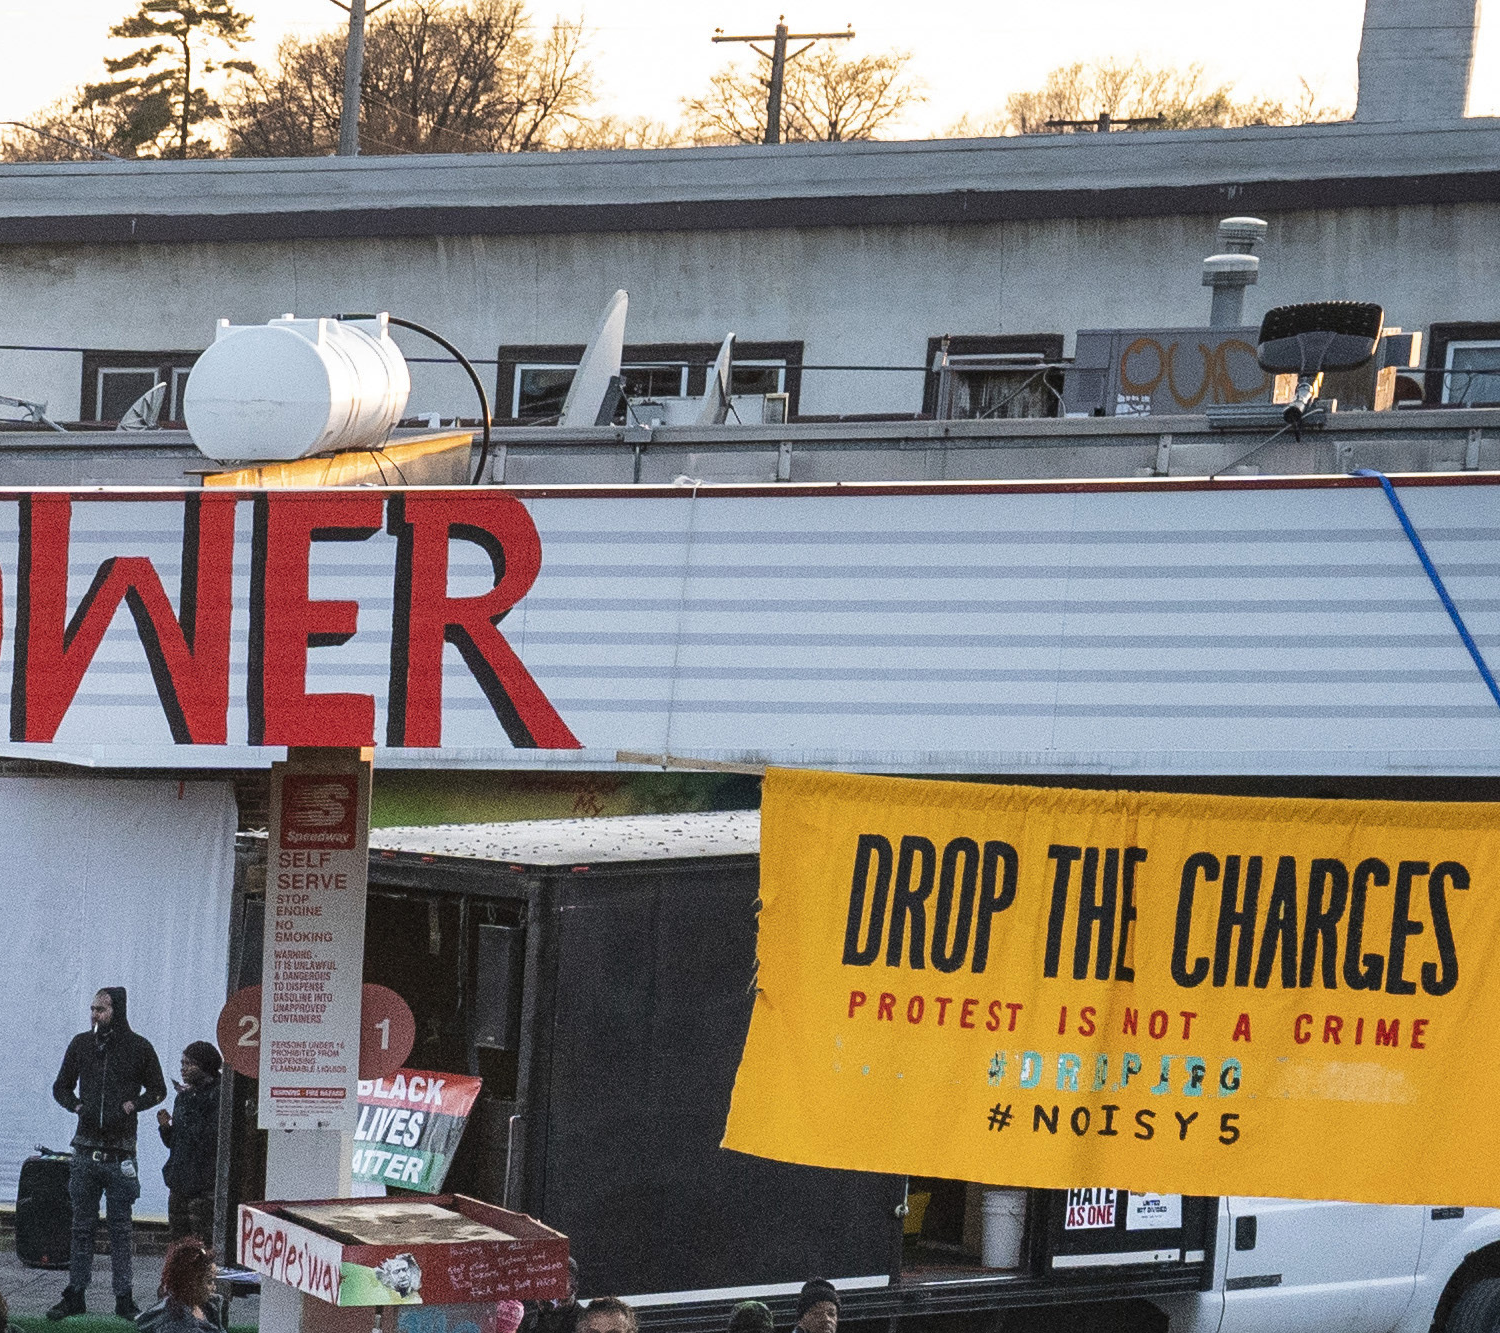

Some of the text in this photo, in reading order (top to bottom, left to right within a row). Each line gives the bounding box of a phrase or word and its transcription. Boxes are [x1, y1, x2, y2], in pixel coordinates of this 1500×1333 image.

[287, 830, 351, 846] Speedway
[280, 851, 331, 868] SELF
[277, 872, 348, 890] SERVE
[276, 893, 310, 905] STOP
[276, 906, 322, 917] ENGINE
[842, 834, 1470, 996] DROP THE CHARGES
[275, 920, 294, 931] NO
[275, 931, 333, 943] SMOKING
[293, 961, 338, 972] UNLAWFUL
[282, 971, 331, 982] DANGEROUS
[846, 989, 1430, 1050] PROTEST IS NOT A CRIME
[237, 1015, 260, 1047] 2
[374, 1018, 390, 1050] 1
[354, 1106, 425, 1149] LIVES
[351, 1146, 424, 1184] ATTER
[1066, 1204, 1114, 1227] AS ONE
